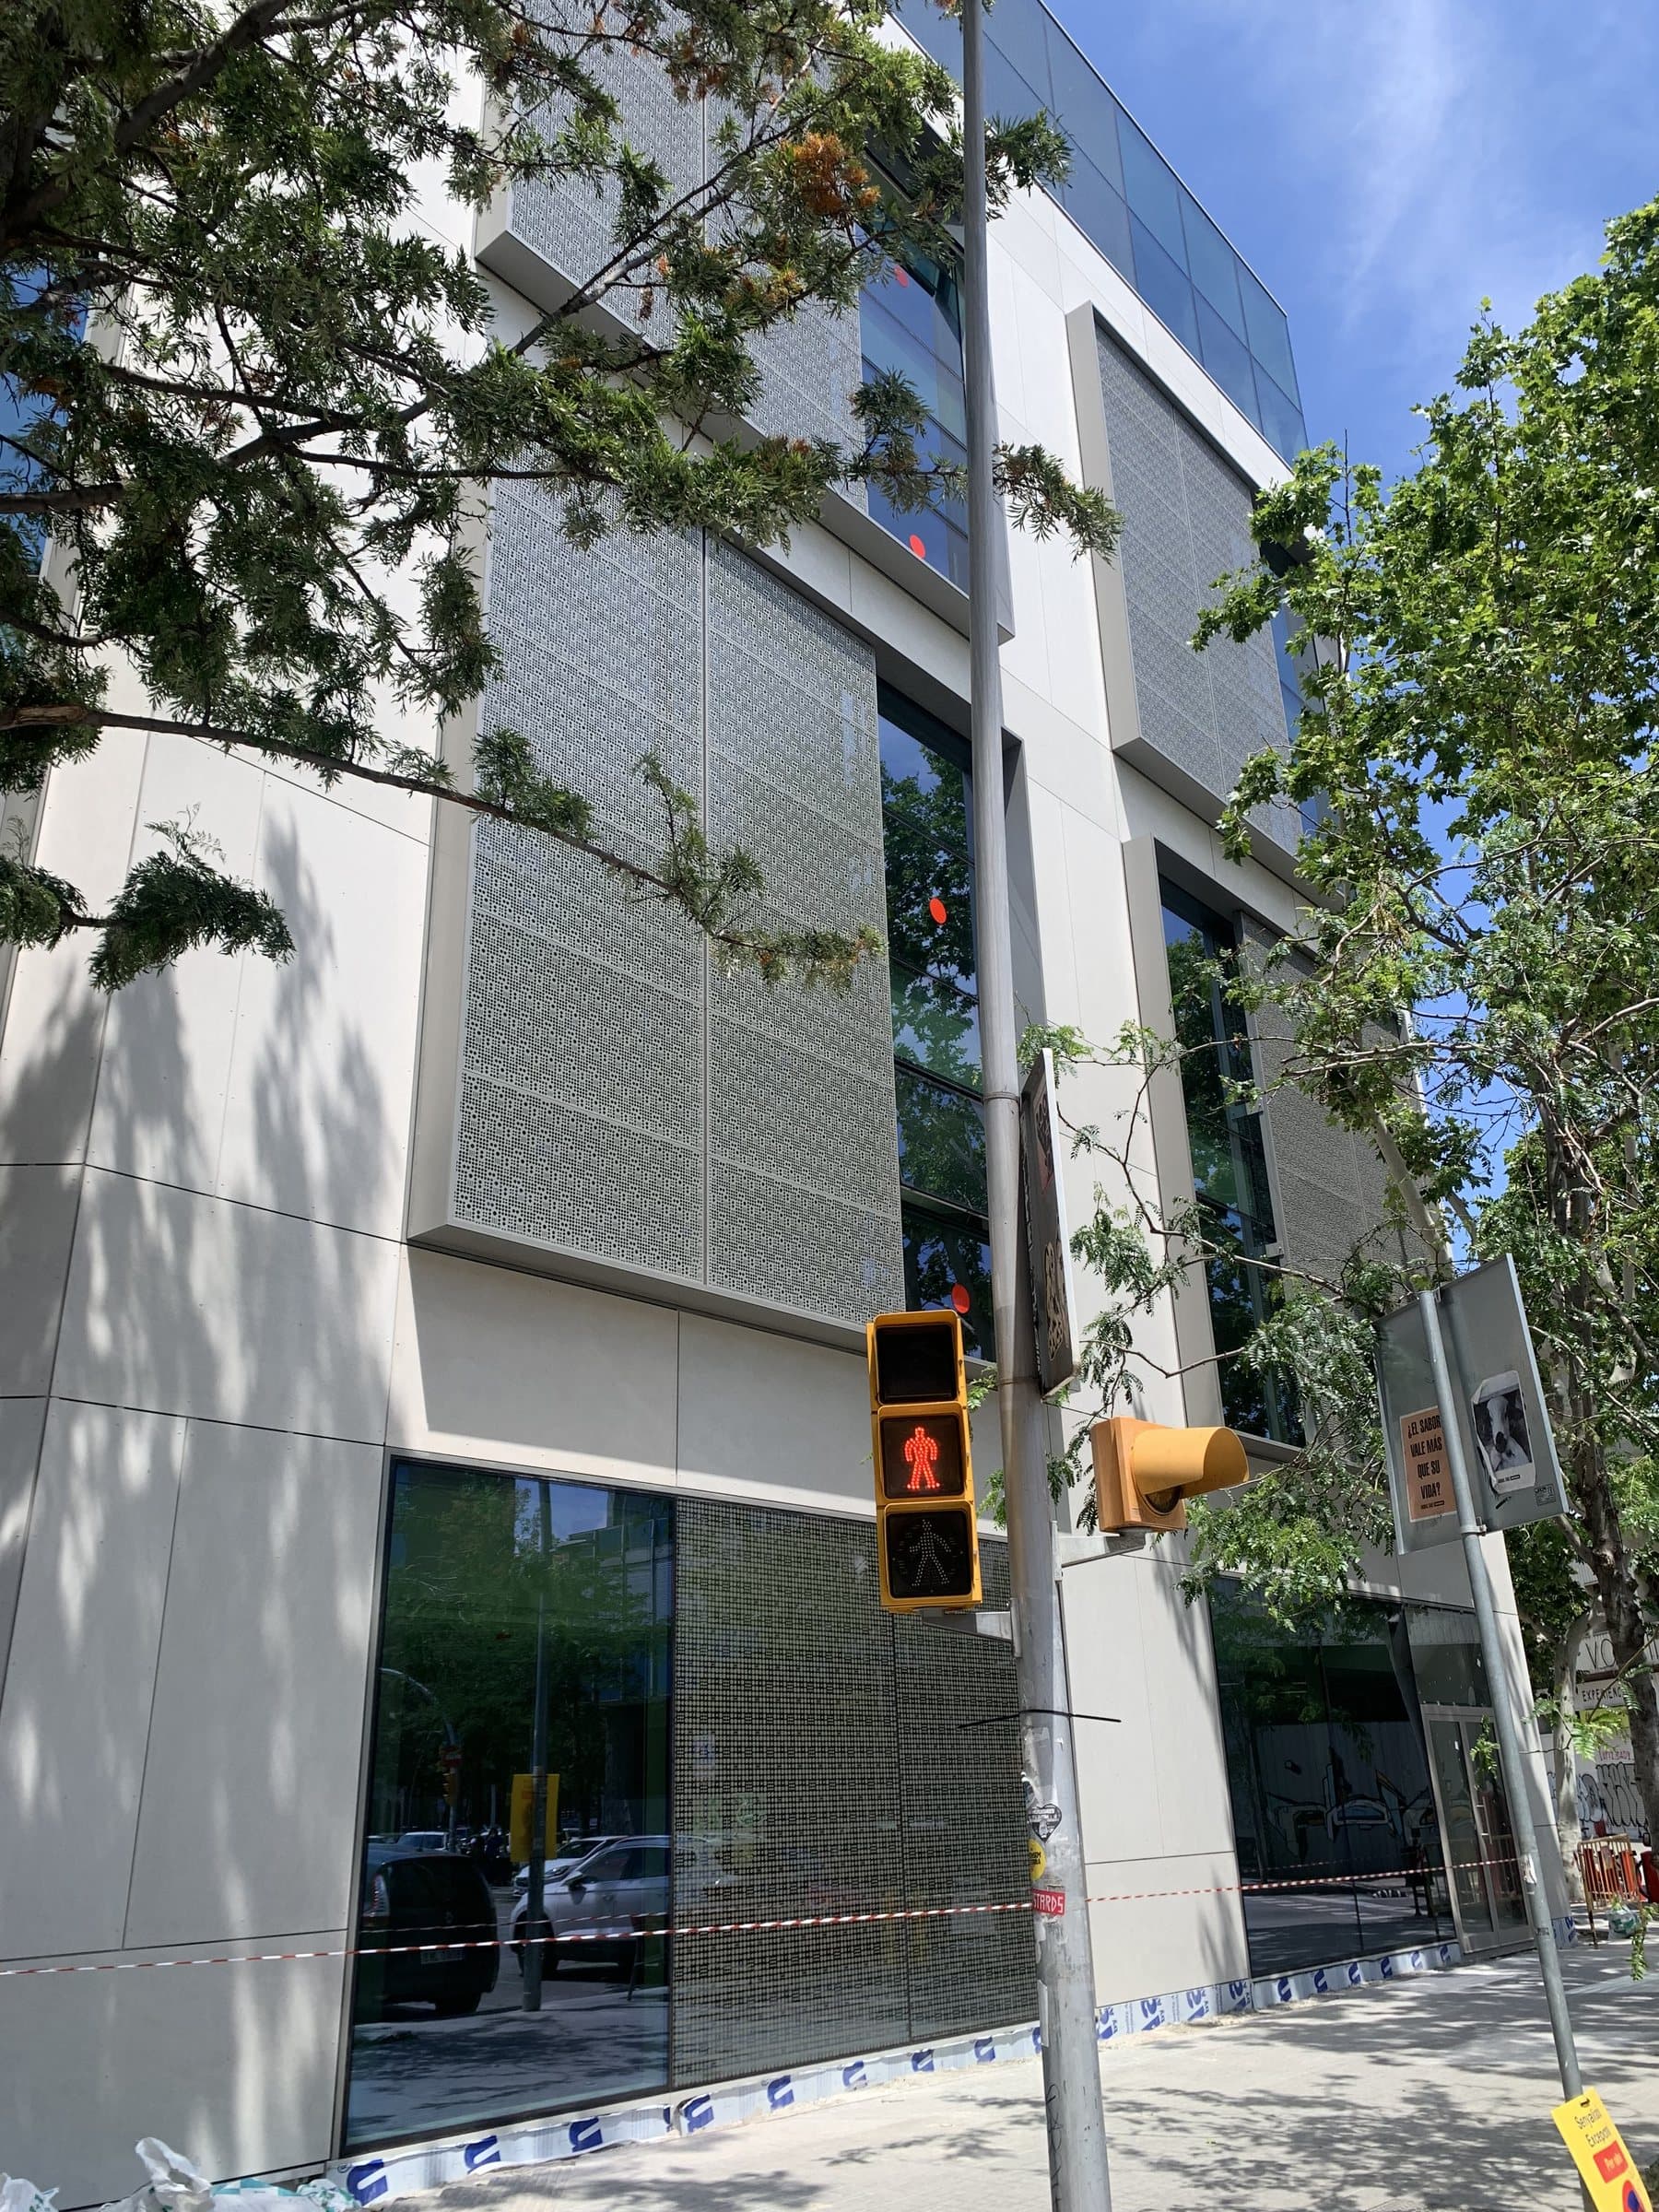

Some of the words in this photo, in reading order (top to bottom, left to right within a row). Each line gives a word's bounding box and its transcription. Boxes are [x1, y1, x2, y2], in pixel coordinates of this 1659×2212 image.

[1407, 1421, 1418, 1439] ¿EL
[1419, 1416, 1442, 1433] SABOR
[1410, 1441, 1426, 1457] VALE
[1427, 1434, 1442, 1453] MÁS
[1418, 1462, 1430, 1479] QUE
[1430, 1459, 1441, 1475] SU
[1420, 1482, 1441, 1500] VIDA?
